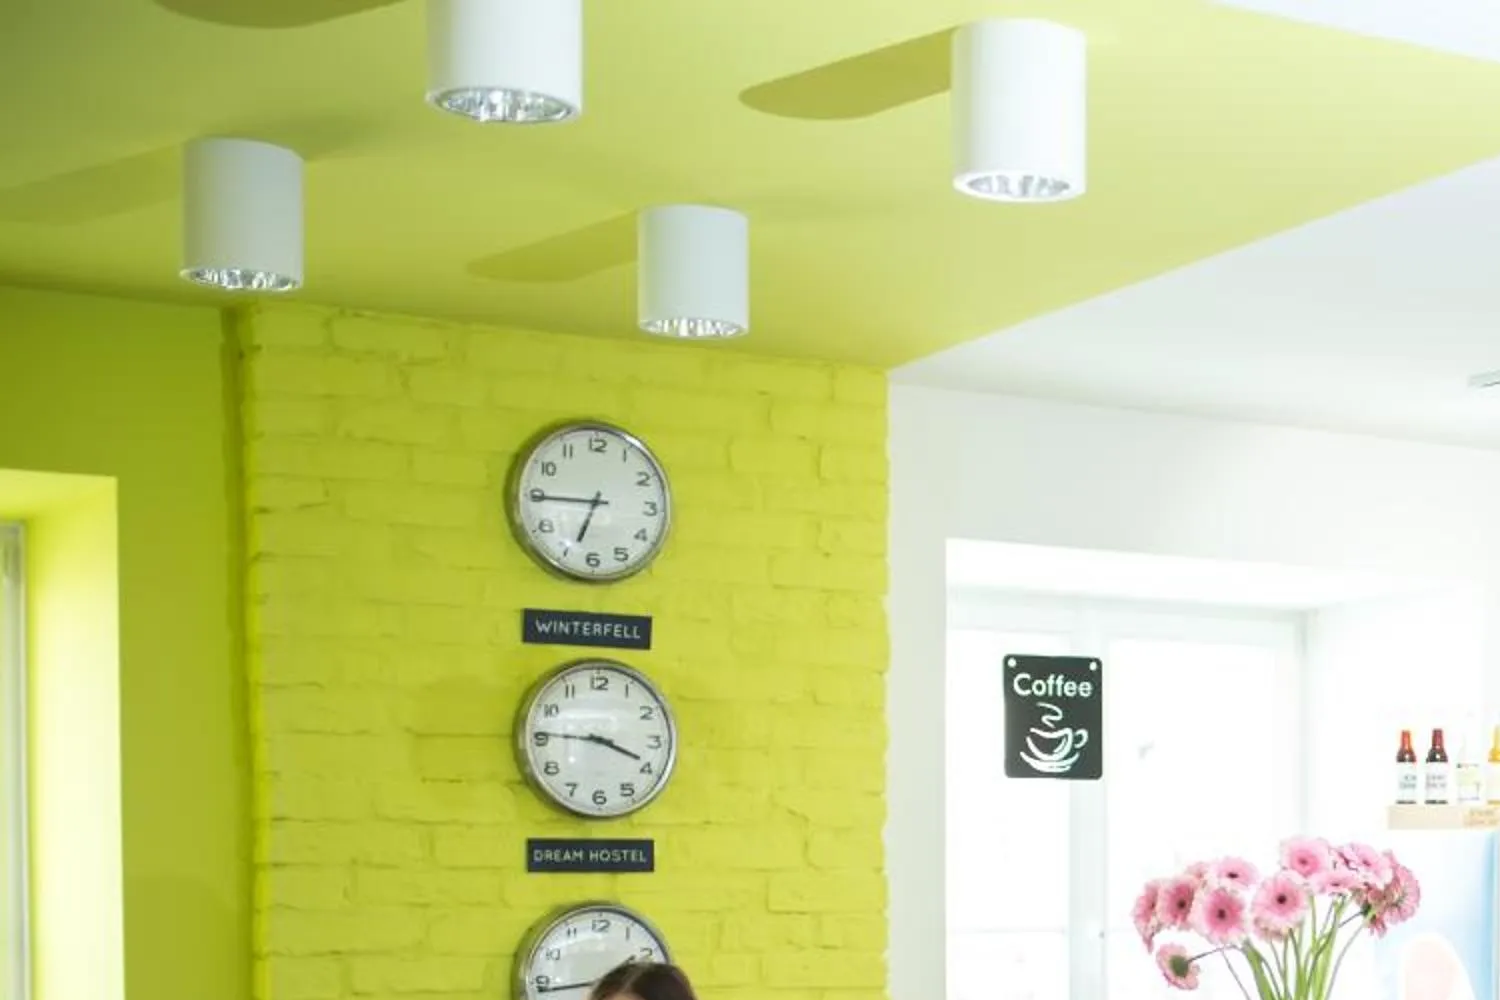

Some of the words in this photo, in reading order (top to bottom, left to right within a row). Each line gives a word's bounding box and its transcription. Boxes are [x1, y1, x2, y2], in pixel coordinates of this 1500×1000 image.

[563, 445, 573, 459] 11
[589, 438, 608, 453] 12
[541, 462, 556, 476] 10
[636, 471, 651, 486] 2
[643, 502, 658, 517] 3
[538, 519, 554, 533] 8
[634, 529, 648, 541] 4
[586, 553, 600, 567] 6
[614, 548, 629, 562] 5
[535, 619, 641, 639] WINTERFELL
[590, 677, 609, 691] 12
[1013, 673, 1092, 697] Coffee
[565, 685, 575, 698] 11
[544, 704, 559, 717] 10
[640, 706, 653, 720] 2
[534, 732, 549, 747] 9
[648, 735, 662, 749] 3
[544, 762, 559, 775] 8
[640, 762, 653, 775] 4
[565, 783, 578, 797] 7
[620, 783, 635, 797] 5
[592, 791, 607, 805] 6
[534, 850, 583, 863] DREAM
[589, 851, 647, 864] HOSTEL
[592, 920, 611, 933] 12
[546, 949, 561, 961] 10
[536, 976, 549, 992] 9
